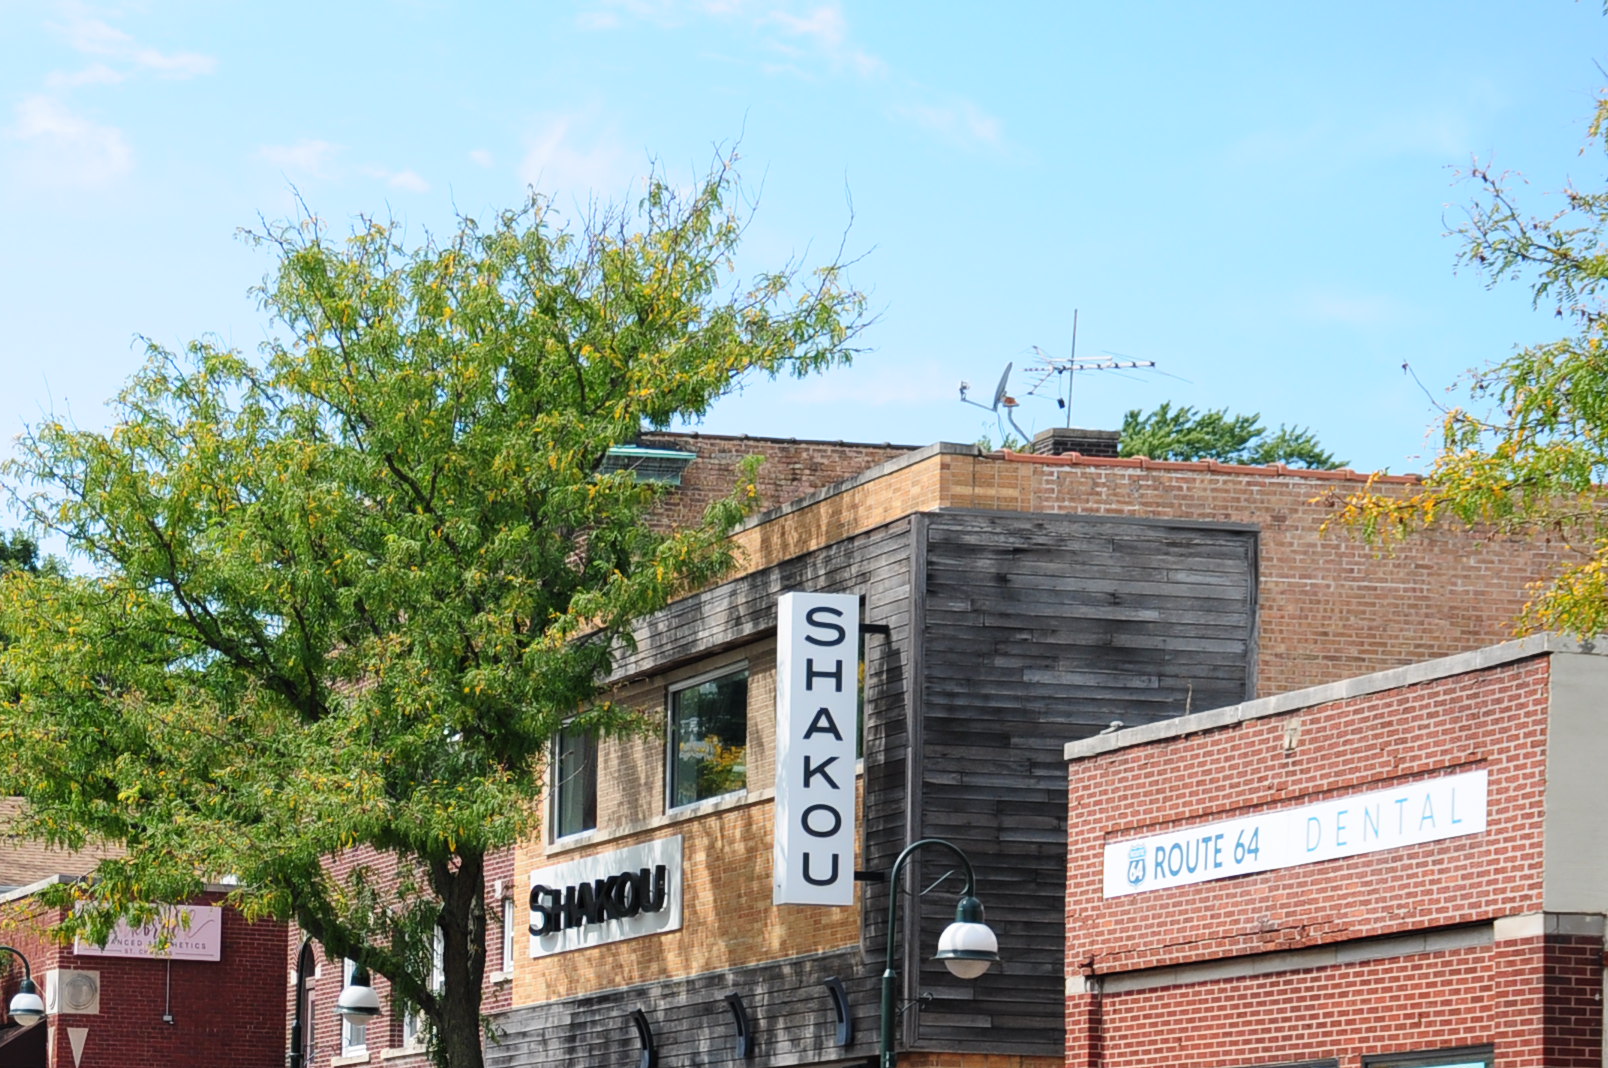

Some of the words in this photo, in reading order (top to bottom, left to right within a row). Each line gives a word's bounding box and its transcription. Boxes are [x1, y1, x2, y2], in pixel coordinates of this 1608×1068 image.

[800, 606, 847, 887] SHAKOU
[1154, 834, 1224, 880] ROUTE
[1234, 827, 1260, 865] 64
[1306, 788, 1462, 853] DENTAL
[528, 865, 667, 937] SHAKOU
[1130, 861, 1144, 881] 64
[111, 939, 143, 947] ANCED
